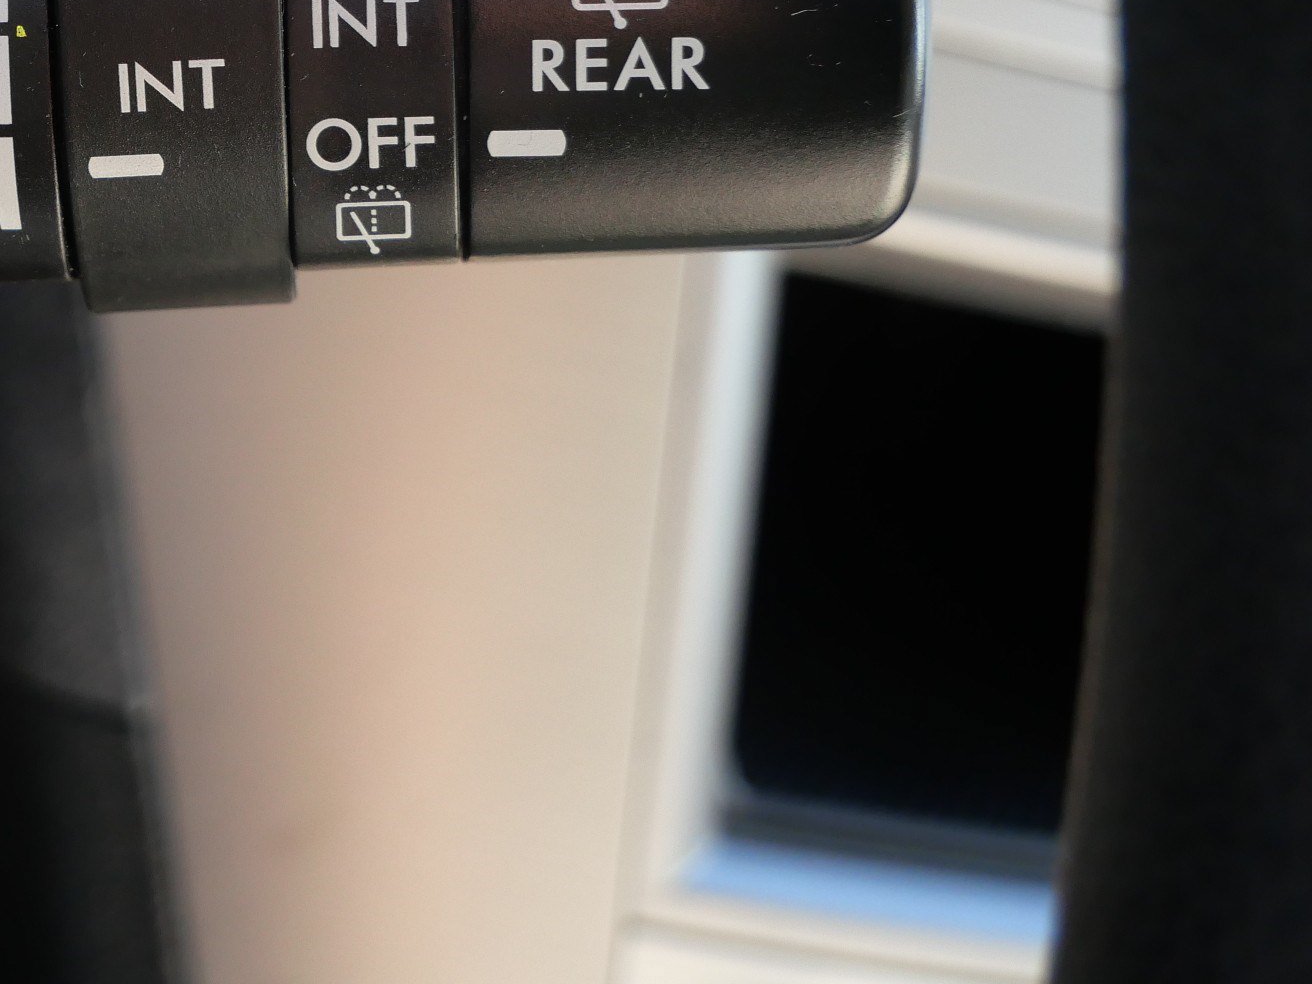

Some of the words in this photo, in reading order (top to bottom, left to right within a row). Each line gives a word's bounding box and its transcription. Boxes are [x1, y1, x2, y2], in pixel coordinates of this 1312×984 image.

[117, 58, 226, 113] INT
[531, 37, 710, 92] REAR
[305, 116, 436, 171] OFF
